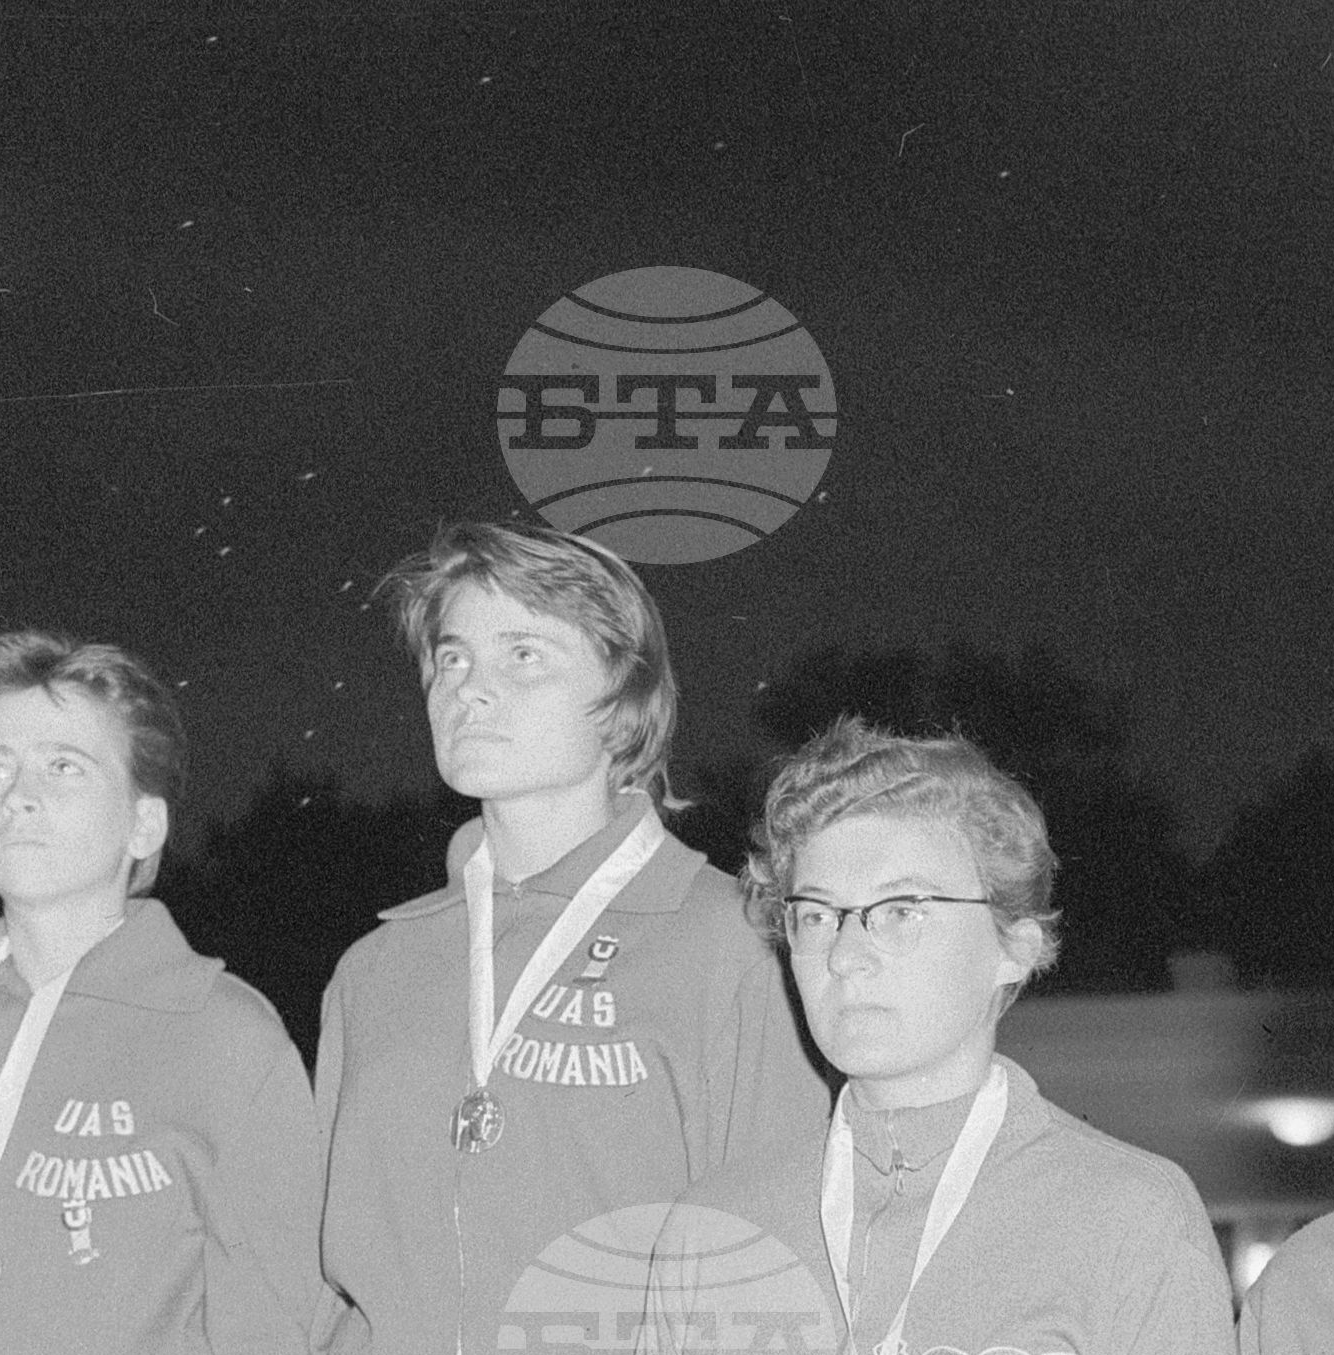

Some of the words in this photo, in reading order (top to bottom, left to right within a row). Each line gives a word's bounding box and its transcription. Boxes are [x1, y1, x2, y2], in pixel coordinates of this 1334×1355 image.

[532, 984, 616, 1027] UAS
[494, 1032, 648, 1085] ROMANIA
[54, 1099, 134, 1136] UAS
[16, 1150, 172, 1200] ROMANIA
